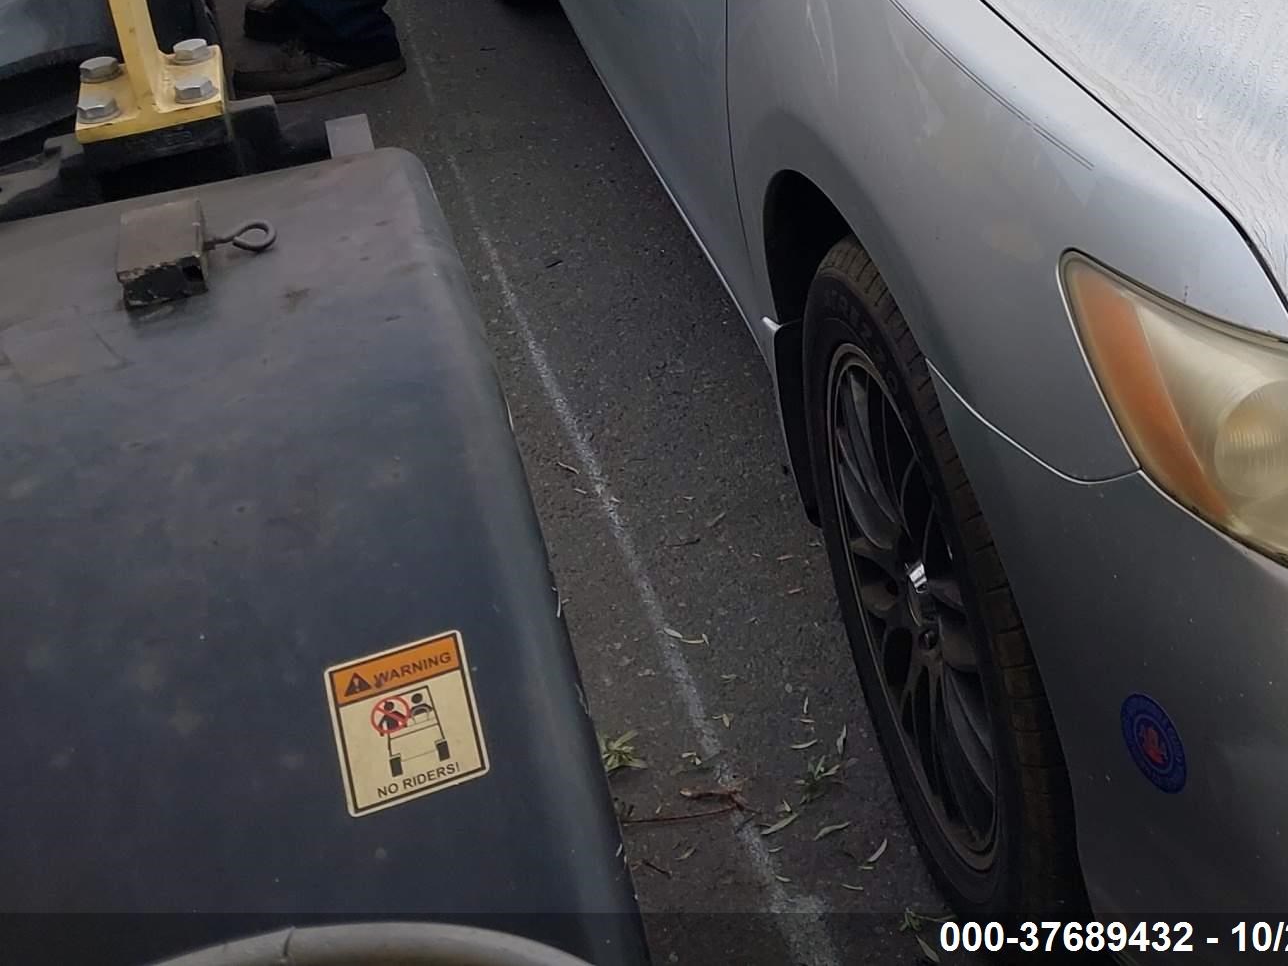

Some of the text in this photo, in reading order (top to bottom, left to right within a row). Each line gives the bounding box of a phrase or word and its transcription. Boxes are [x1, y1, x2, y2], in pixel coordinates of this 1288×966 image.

[373, 652, 451, 685] WARNING
[377, 761, 460, 799] NO RIDERS!
